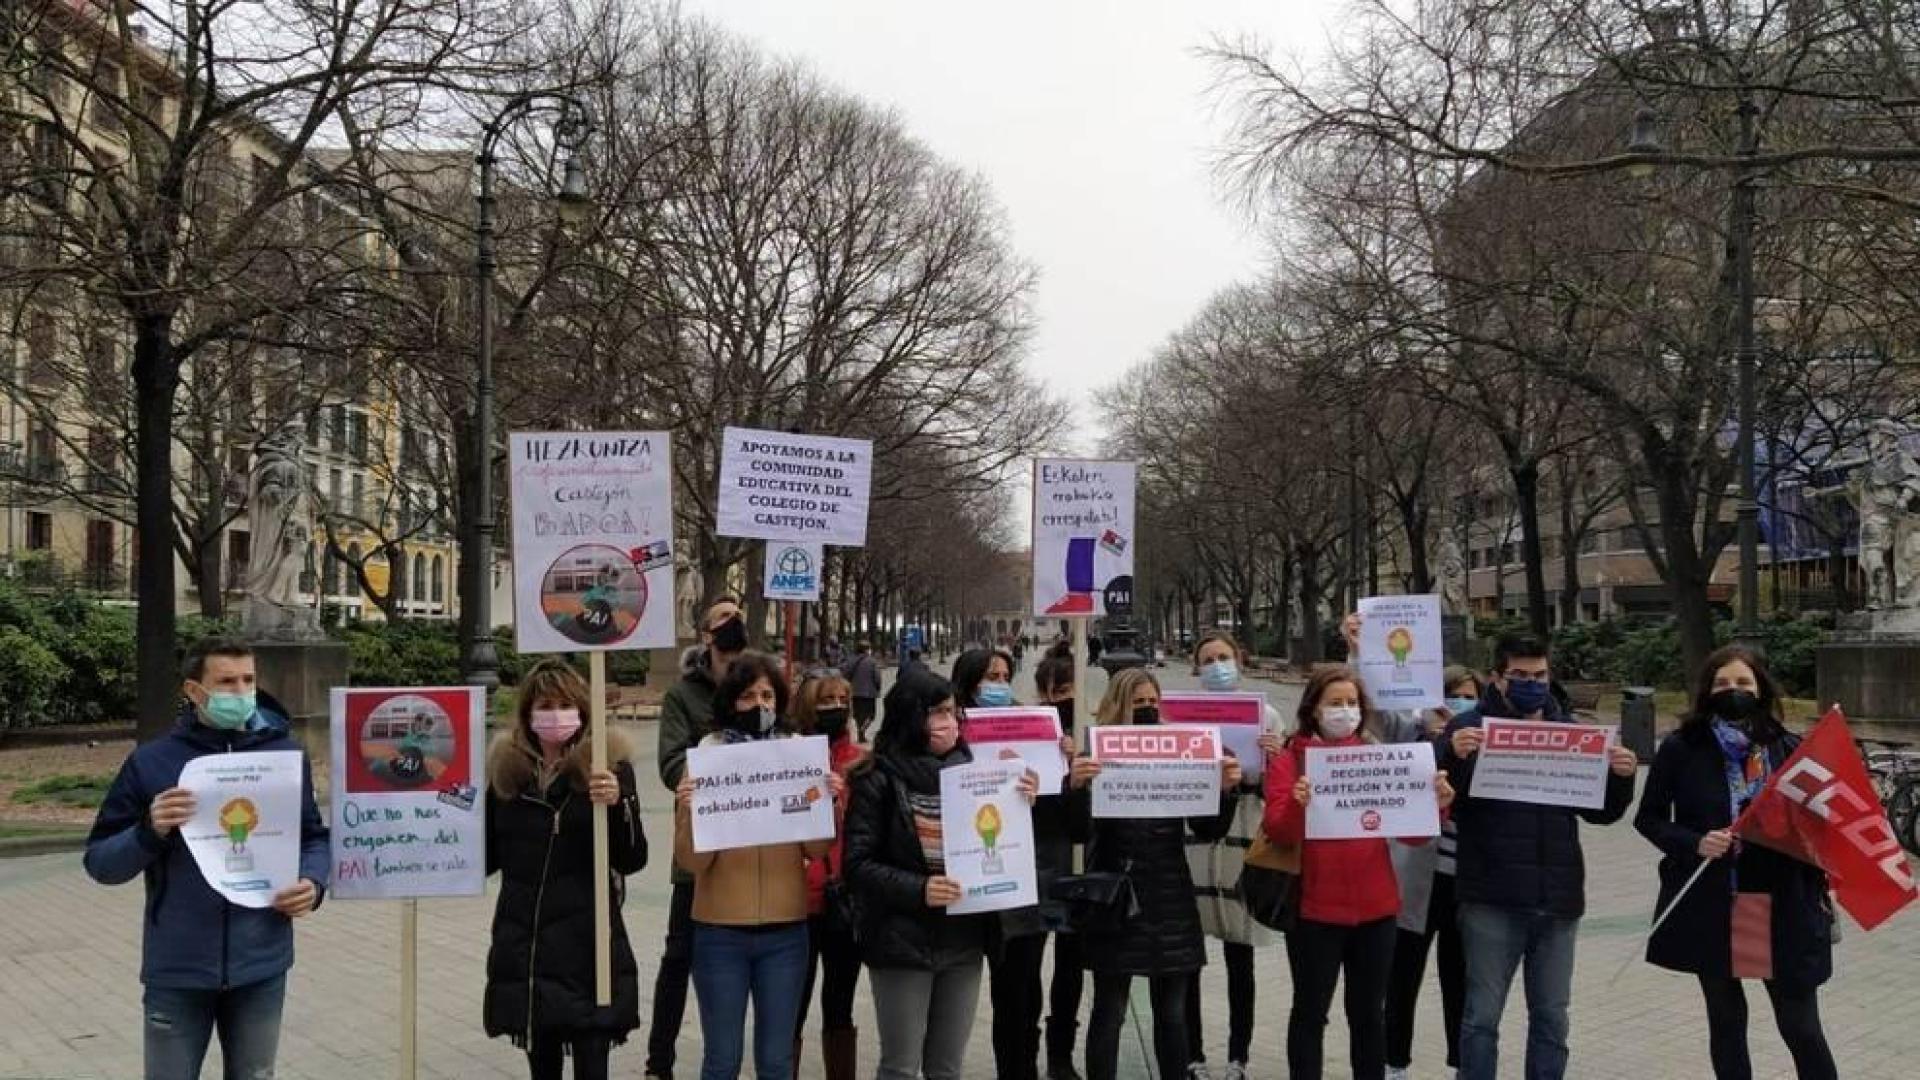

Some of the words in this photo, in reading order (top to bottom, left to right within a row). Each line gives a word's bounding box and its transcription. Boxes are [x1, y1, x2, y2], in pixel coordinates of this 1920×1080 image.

[527, 439, 650, 462] HEZKUNTZA
[740, 441, 823, 459] APOYAMOS
[825, 449, 835, 461] A
[838, 451, 856, 463] LA
[751, 460, 844, 479] COMUNIDAD
[738, 476, 821, 495] EDUCATIVA
[824, 484, 853, 497] DEL
[748, 494, 817, 511] COLEGIO
[820, 501, 841, 513] DE
[771, 575, 815, 589] ANPE
[1109, 590, 1130, 604] PAI
[1102, 735, 1177, 753] CCOO
[1494, 728, 1570, 747] CCOO
[1326, 751, 1384, 763] RESPETO
[1387, 751, 1396, 761] A
[1398, 750, 1414, 761] LA
[695, 772, 742, 789] PAI-tik
[748, 766, 823, 784] ateratzeko
[1393, 766, 1410, 777] DE
[1384, 782, 1393, 791] Y
[1396, 781, 1405, 790] A
[1409, 781, 1426, 790] SU
[698, 796, 770, 815] eskubidea
[1335, 796, 1406, 809] ALUMNADO
[343, 800, 378, 828] Que
[384, 806, 402, 821] no
[338, 859, 368, 880] PAI
